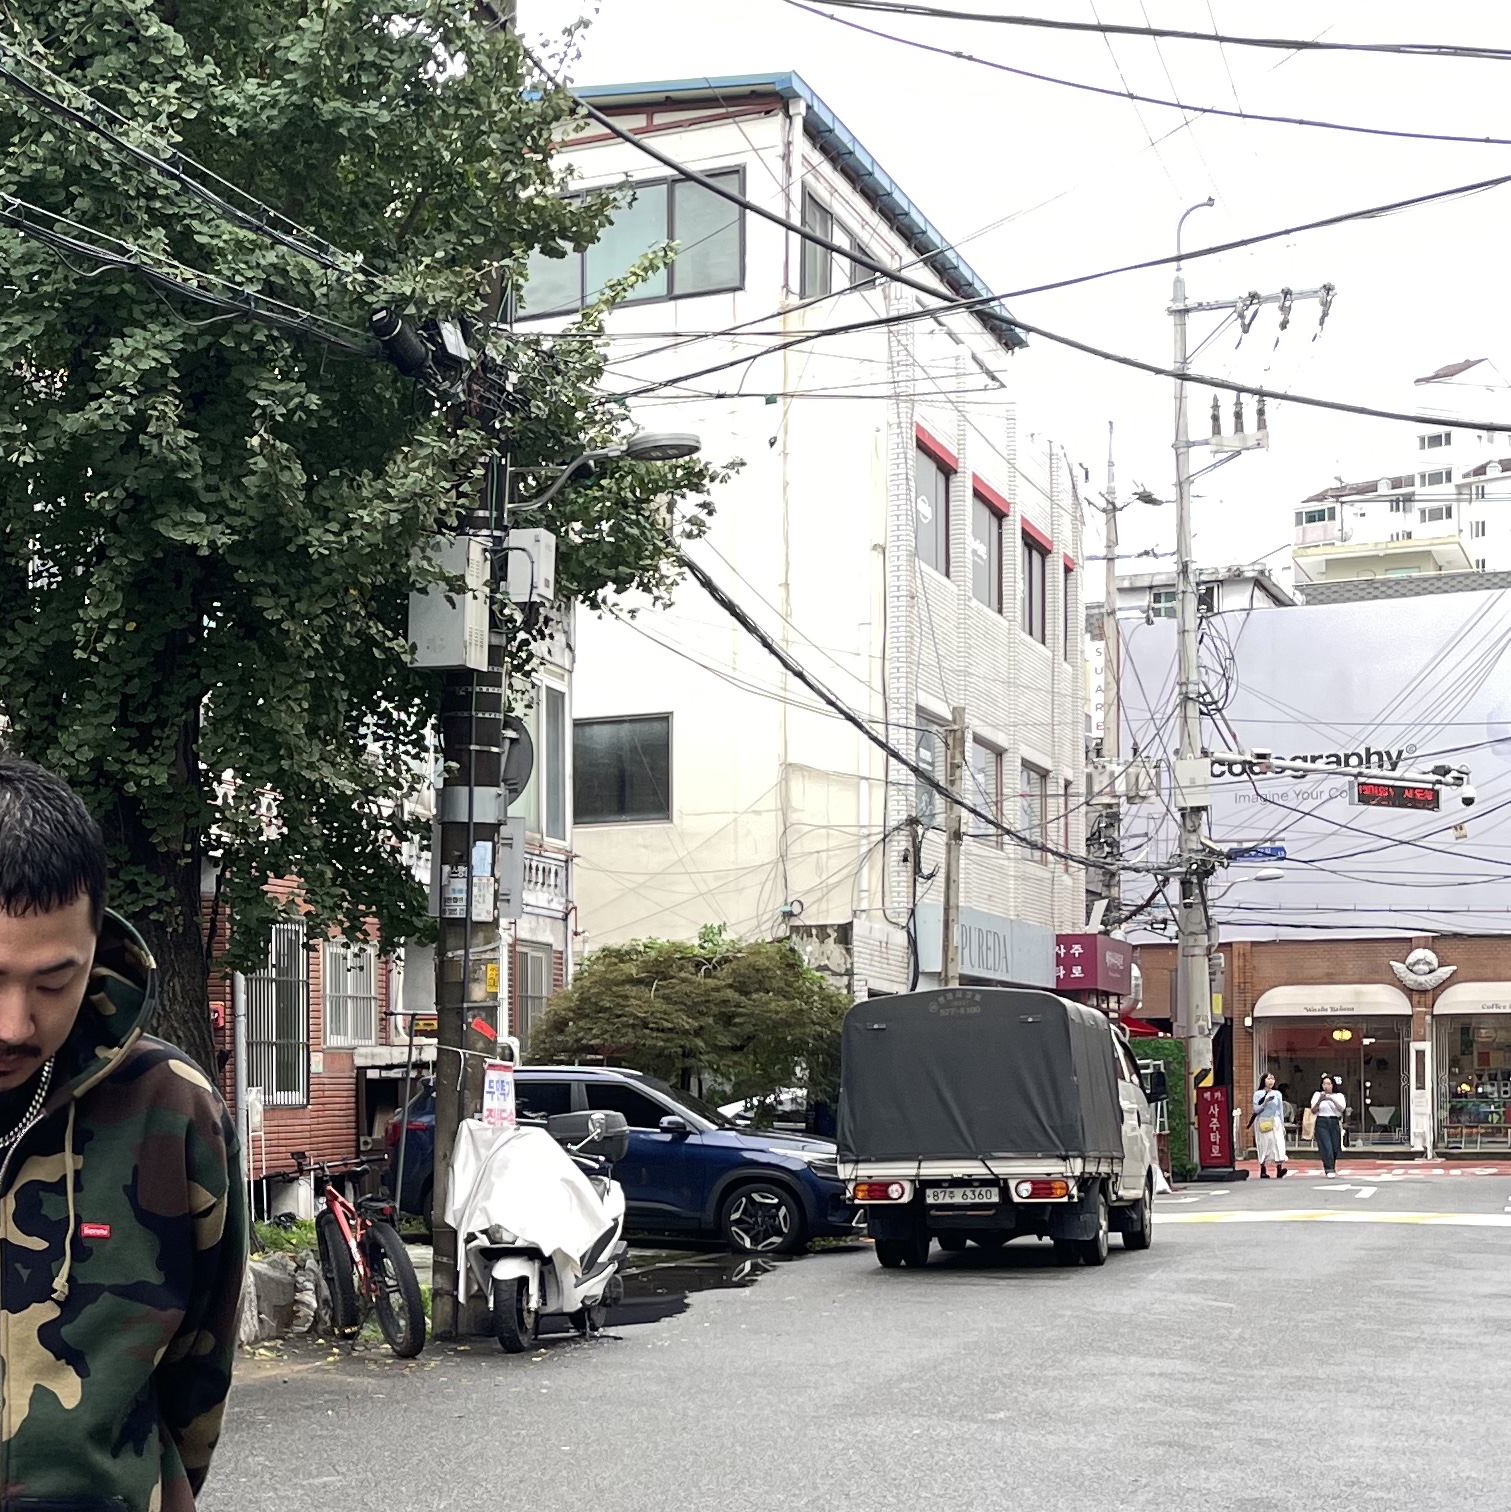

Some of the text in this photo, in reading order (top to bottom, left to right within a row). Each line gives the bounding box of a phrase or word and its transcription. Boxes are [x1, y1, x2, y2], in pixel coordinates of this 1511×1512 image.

[1235, 790, 1289, 805] Imagine
[1293, 788, 1325, 801] Your
[960, 923, 1009, 974] PUREDA
[1208, 1103, 1222, 1157] 사주타로
[961, 1188, 992, 1201] 6360
